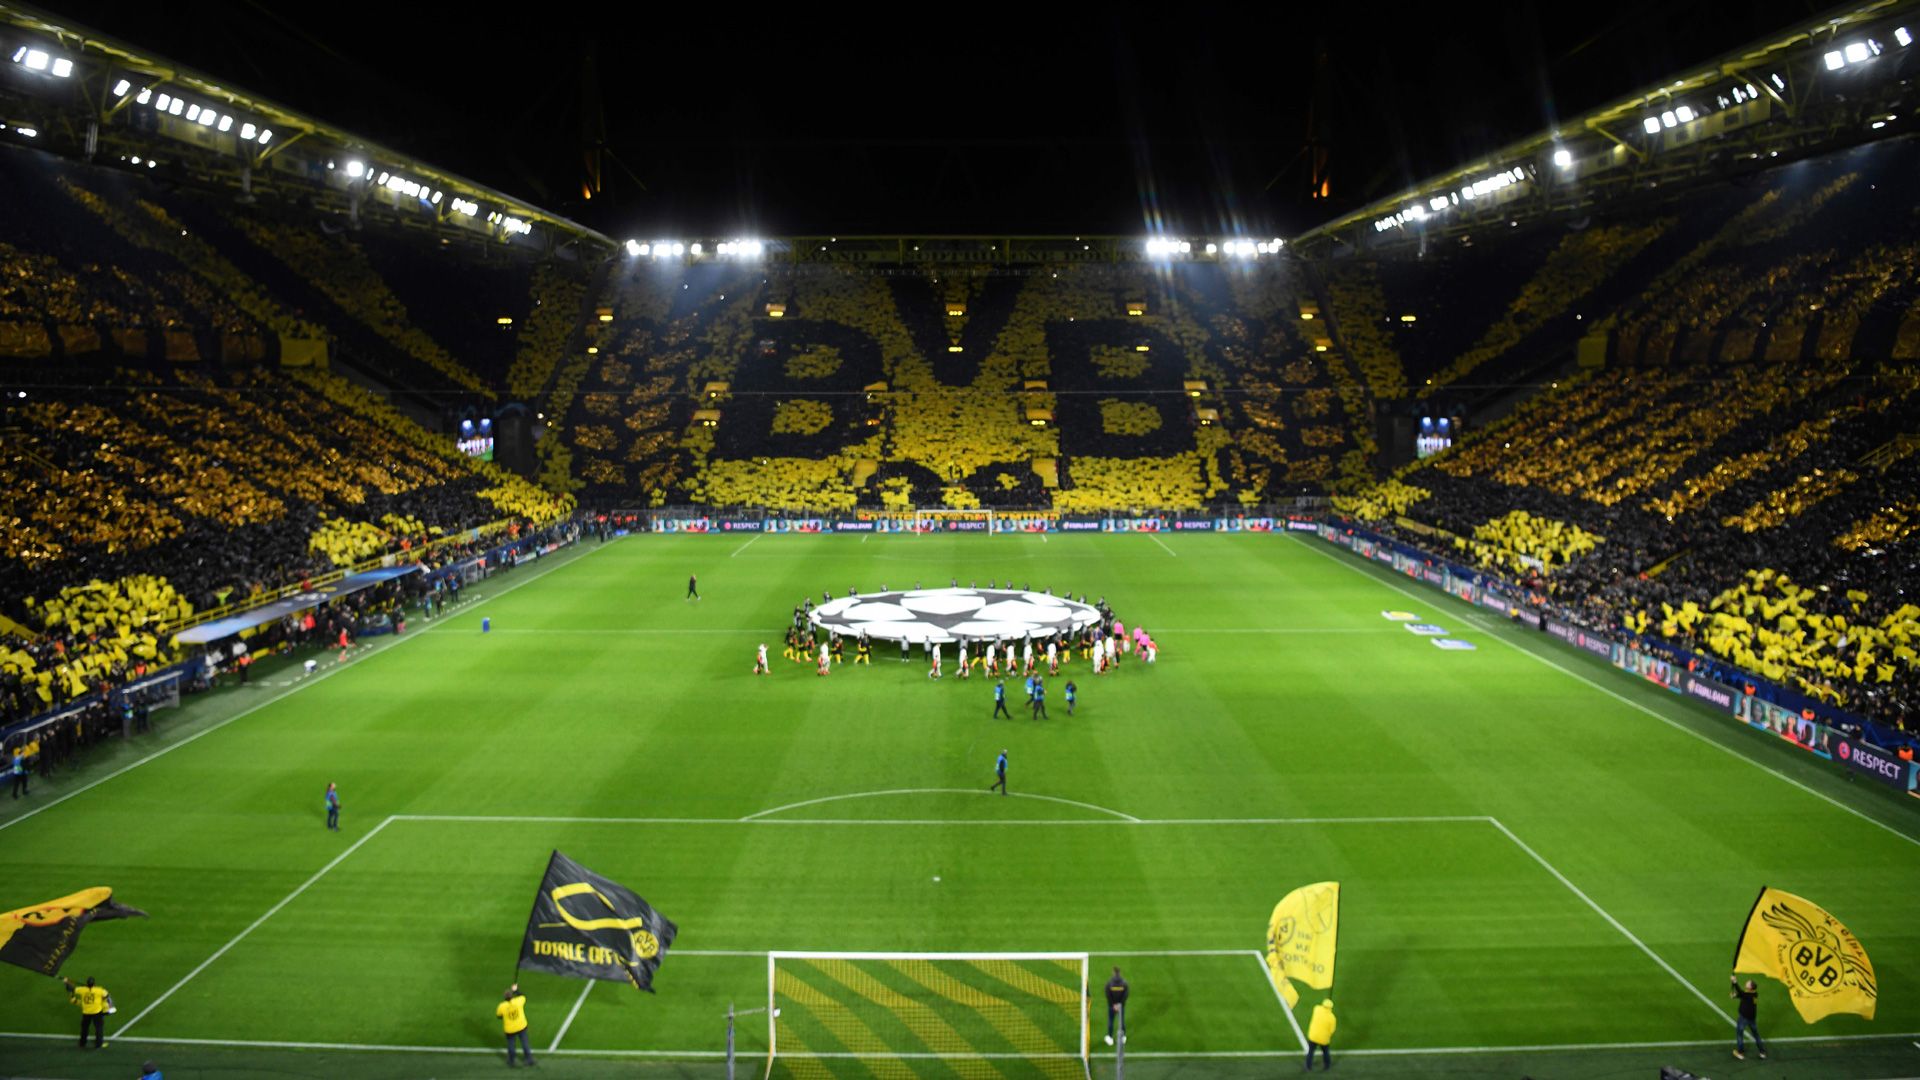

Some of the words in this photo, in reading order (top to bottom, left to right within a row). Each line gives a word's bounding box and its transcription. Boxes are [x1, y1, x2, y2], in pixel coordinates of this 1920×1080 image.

[733, 522, 760, 530] RESPECT
[958, 522, 986, 530] RESPECT
[1184, 522, 1212, 530] RESPECT
[1585, 635, 1610, 656] RESPECT
[1853, 747, 1902, 780] RESPECT
[532, 940, 586, 963] TOTALE
[1795, 945, 1838, 987] BVB
[1799, 969, 1816, 987] 09
